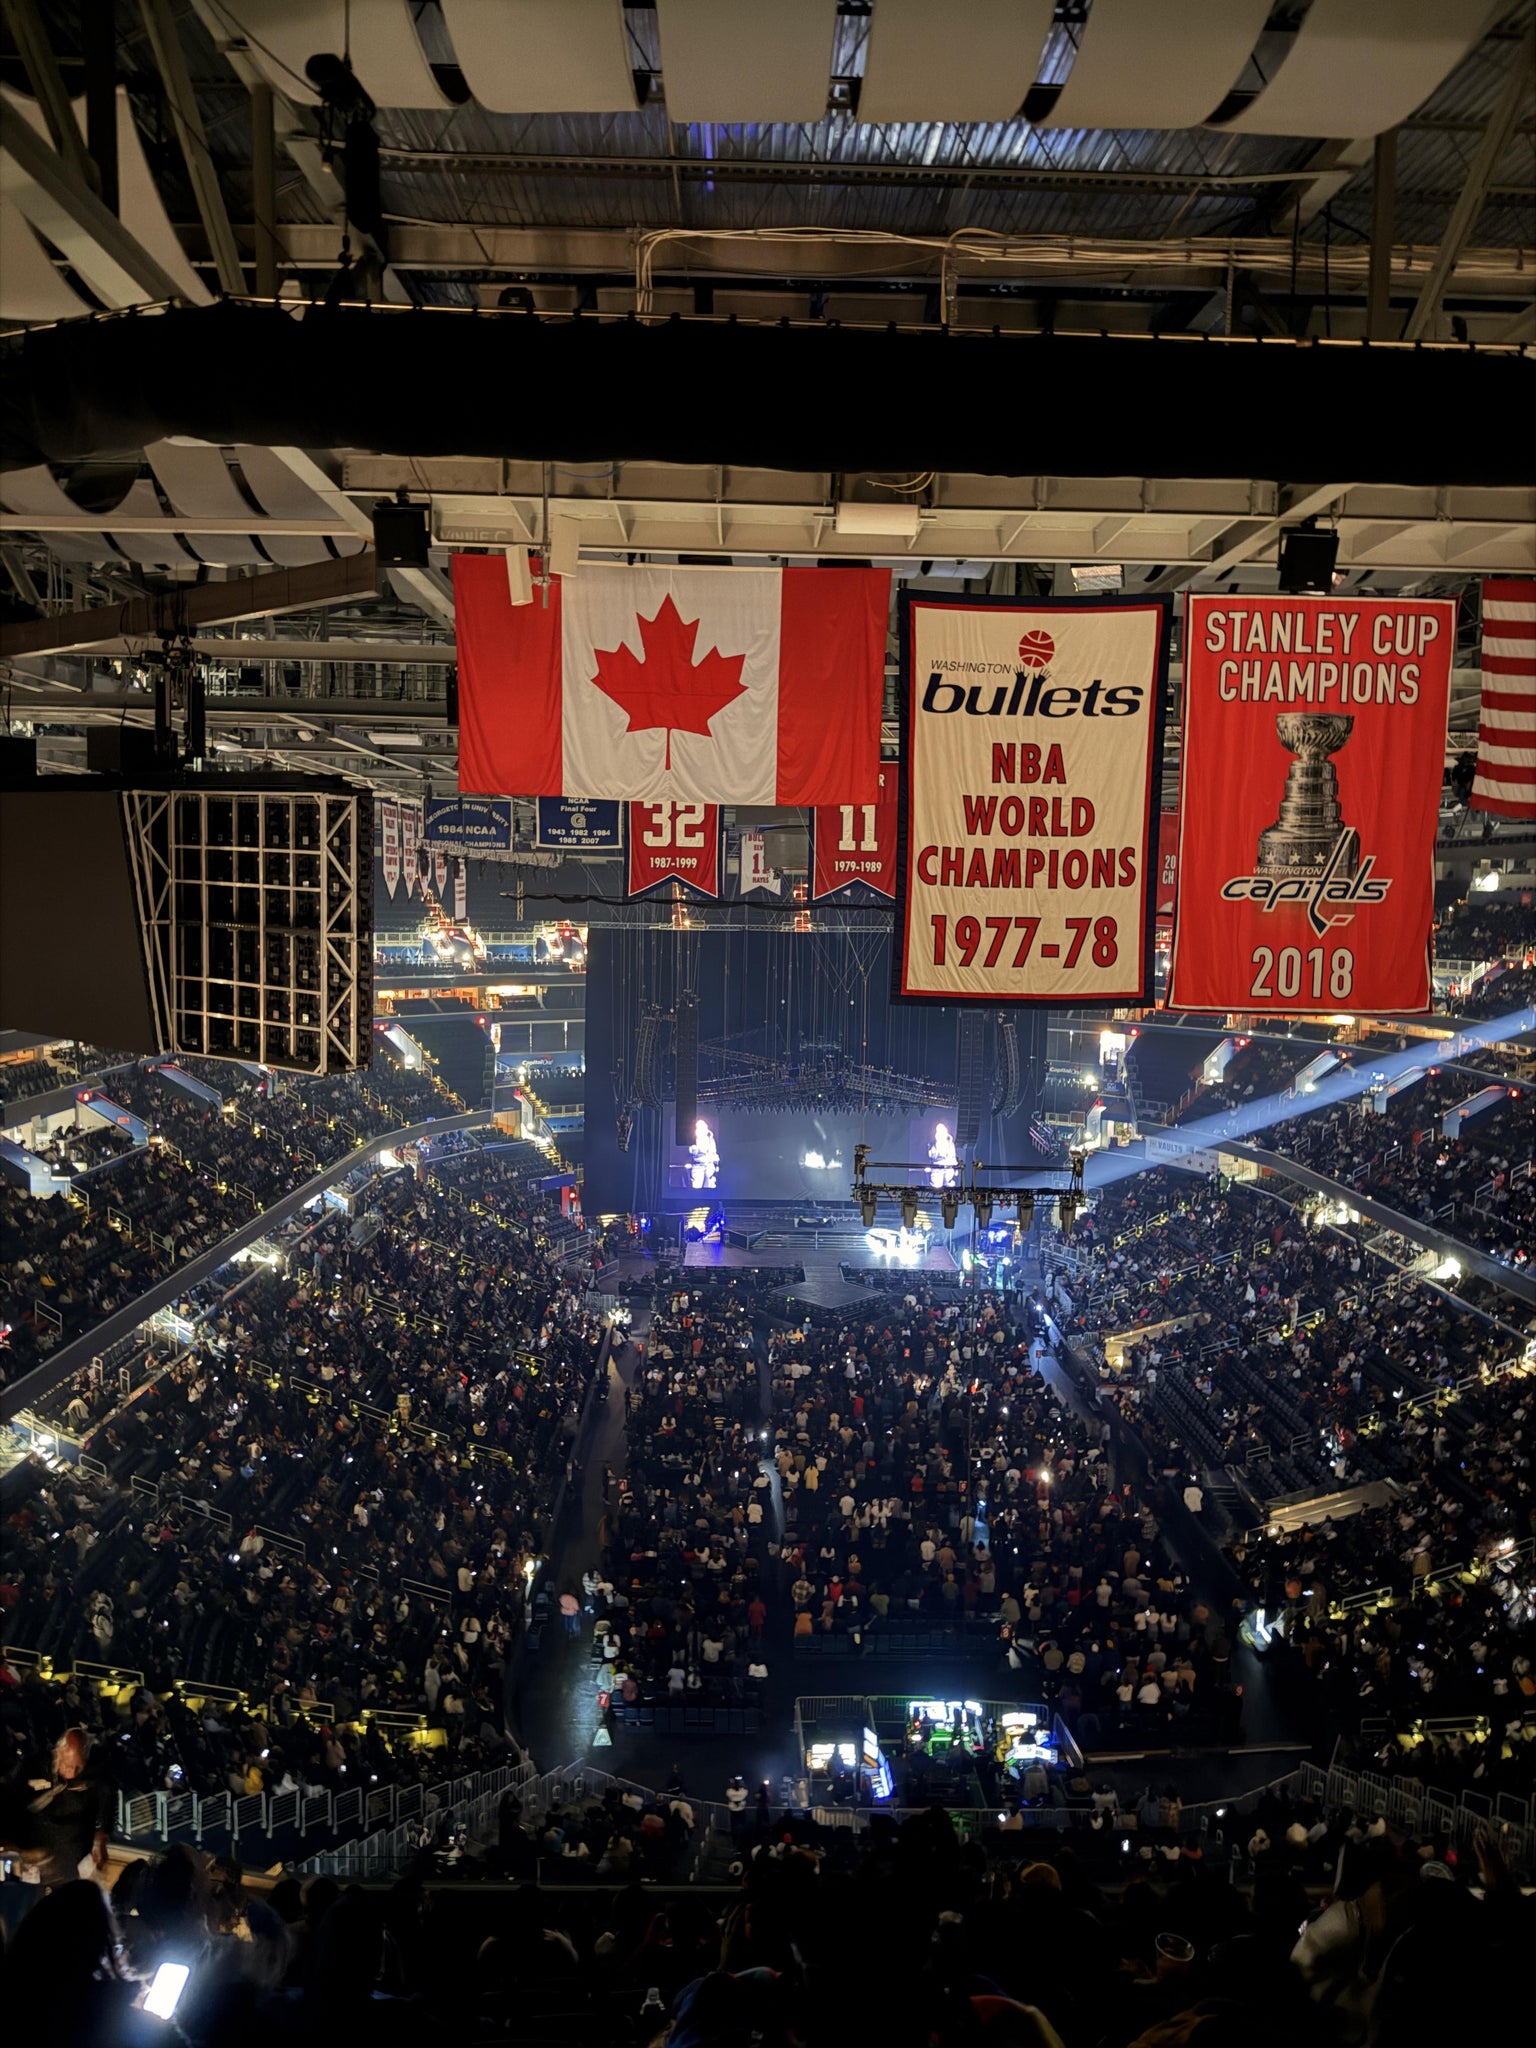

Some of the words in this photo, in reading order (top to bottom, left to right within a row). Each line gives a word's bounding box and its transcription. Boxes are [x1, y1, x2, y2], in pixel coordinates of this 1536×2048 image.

[1205, 610, 1359, 655] STANLEY
[1372, 614, 1440, 657] CUP
[930, 659, 1012, 675] WASHINGTON
[1218, 660, 1420, 705] CHAMPIONS
[921, 664, 1144, 718] bullets
[991, 742, 1067, 785] NBA
[438, 825, 463, 834] 1984
[465, 825, 497, 836] NCAA
[560, 805, 579, 813] Final
[580, 805, 598, 813] Four
[643, 801, 705, 847] 32
[839, 804, 878, 852] 11
[962, 795, 1096, 838] WORLD
[581, 837, 600, 845] 2007
[650, 857, 698, 868] 1987-1999
[1164, 855, 1177, 869] 20
[834, 861, 882, 872] 1979-1989
[917, 845, 1137, 890] CHAMPIONS
[1220, 827, 1393, 940] capitals
[1252, 866, 1323, 876] WASHINGTON
[931, 914, 1118, 969] 1977-78
[1249, 946, 1354, 1000] 2018
[1158, 1141, 1183, 1154] VAULTS
[600, 1693, 607, 1705] 7
